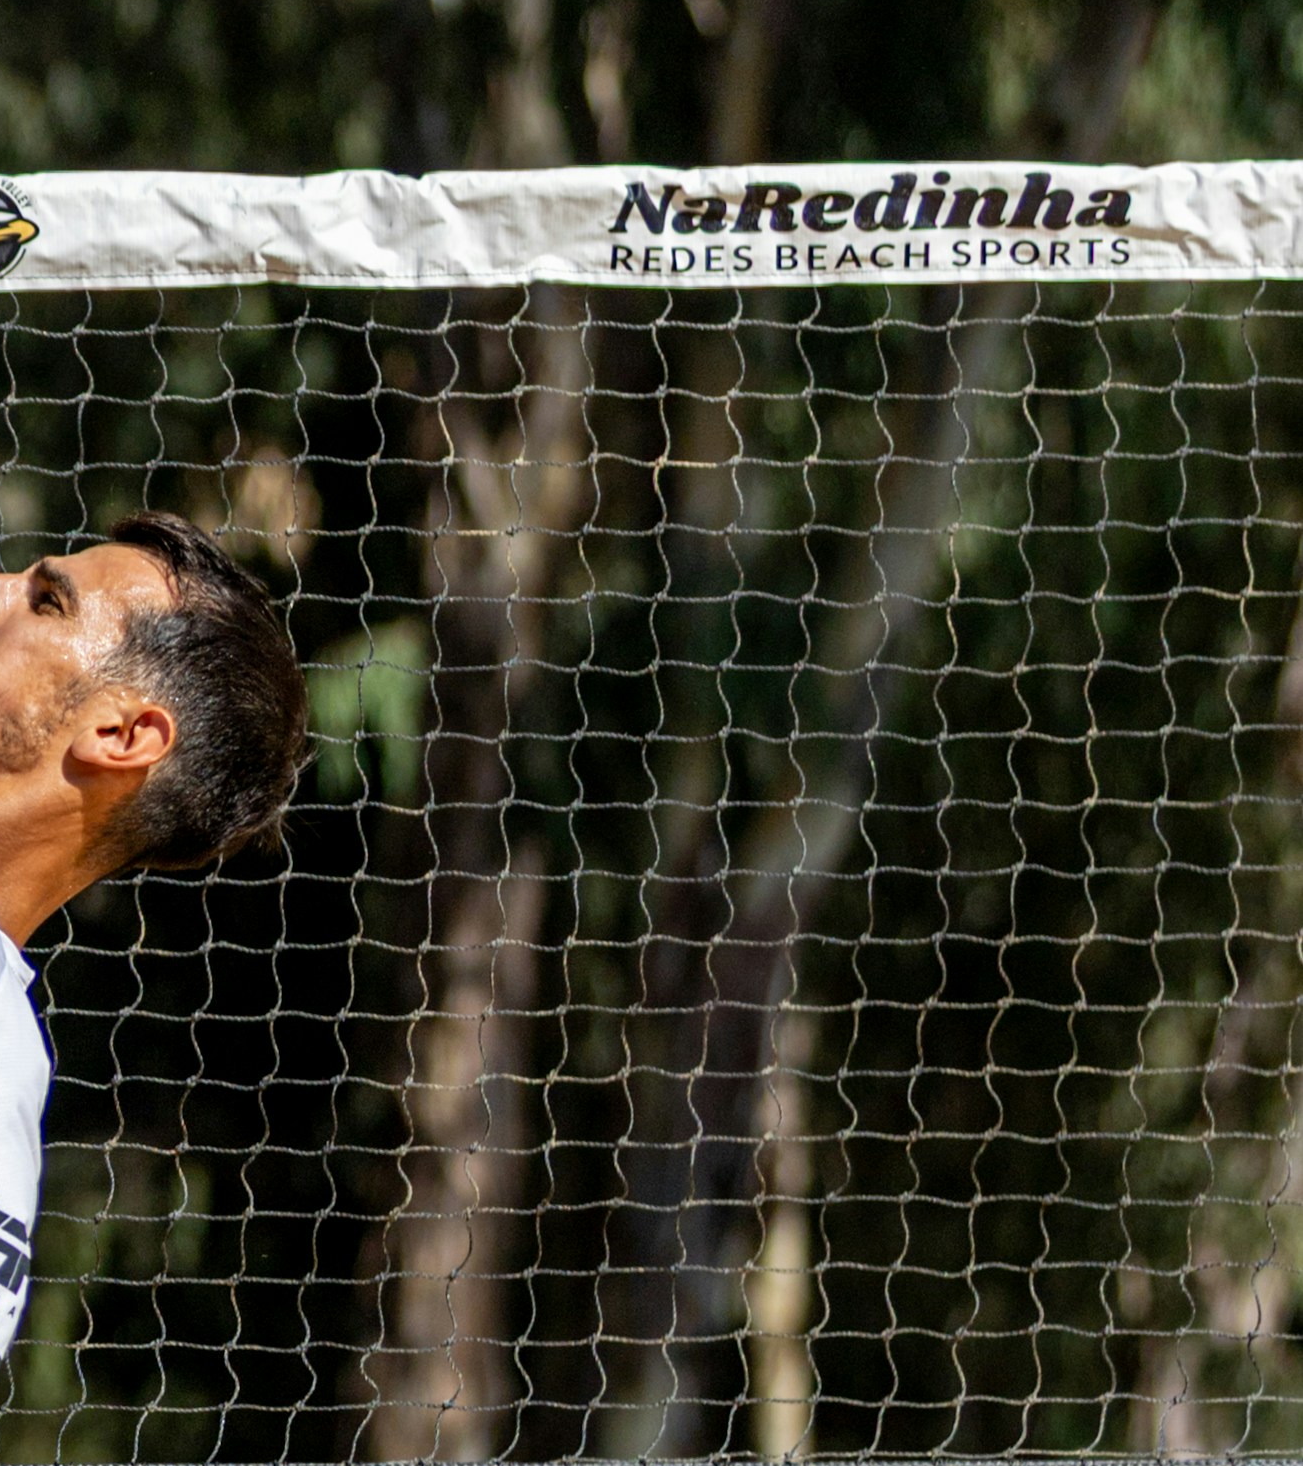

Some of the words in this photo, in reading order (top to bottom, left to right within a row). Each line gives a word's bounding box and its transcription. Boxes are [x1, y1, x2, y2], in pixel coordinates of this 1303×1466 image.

[607, 171, 1132, 235] NaRedinha
[610, 243, 754, 273] REDES
[775, 241, 931, 271] BEACH
[951, 238, 1131, 268] SPORTS
